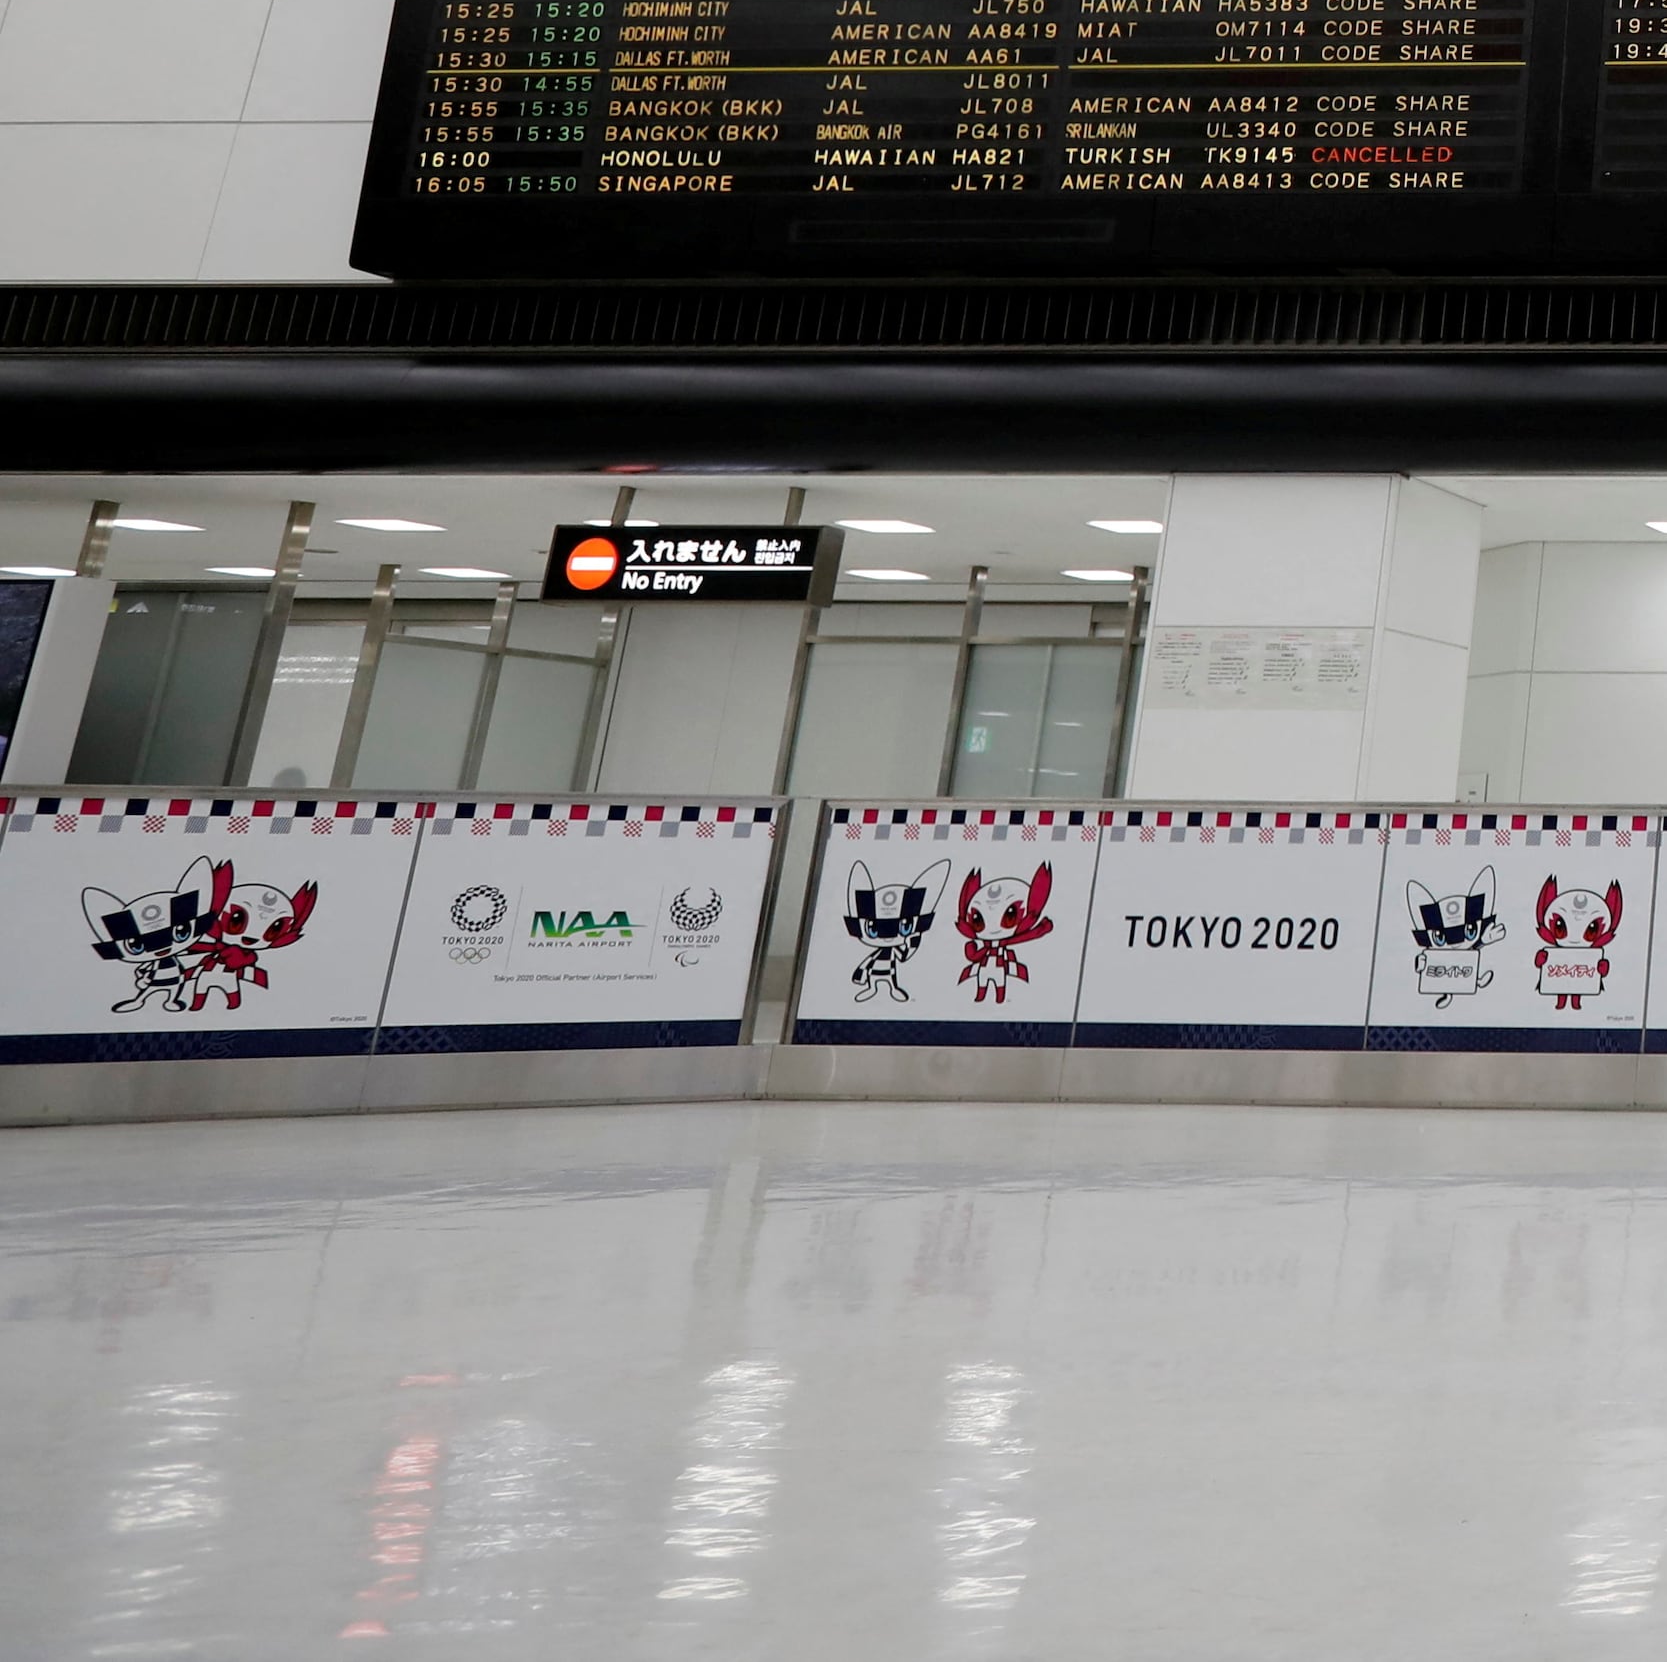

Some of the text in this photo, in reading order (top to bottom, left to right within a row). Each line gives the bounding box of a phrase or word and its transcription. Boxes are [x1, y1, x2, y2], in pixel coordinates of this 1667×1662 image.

[421, 147, 1452, 167] 16:00 HONOLULU HAWAIIAN HA821 TURKISH TK9145 CANCELLED
[626, 540, 746, 563] 入れません
[622, 572, 703, 594] No Entry
[530, 911, 633, 938] NAA
[1125, 916, 1338, 949] TOKYO 2020
[443, 937, 476, 945] TOKYO
[663, 935, 720, 943] TOKYO 2020
[1548, 965, 1595, 978] ソメイティ
